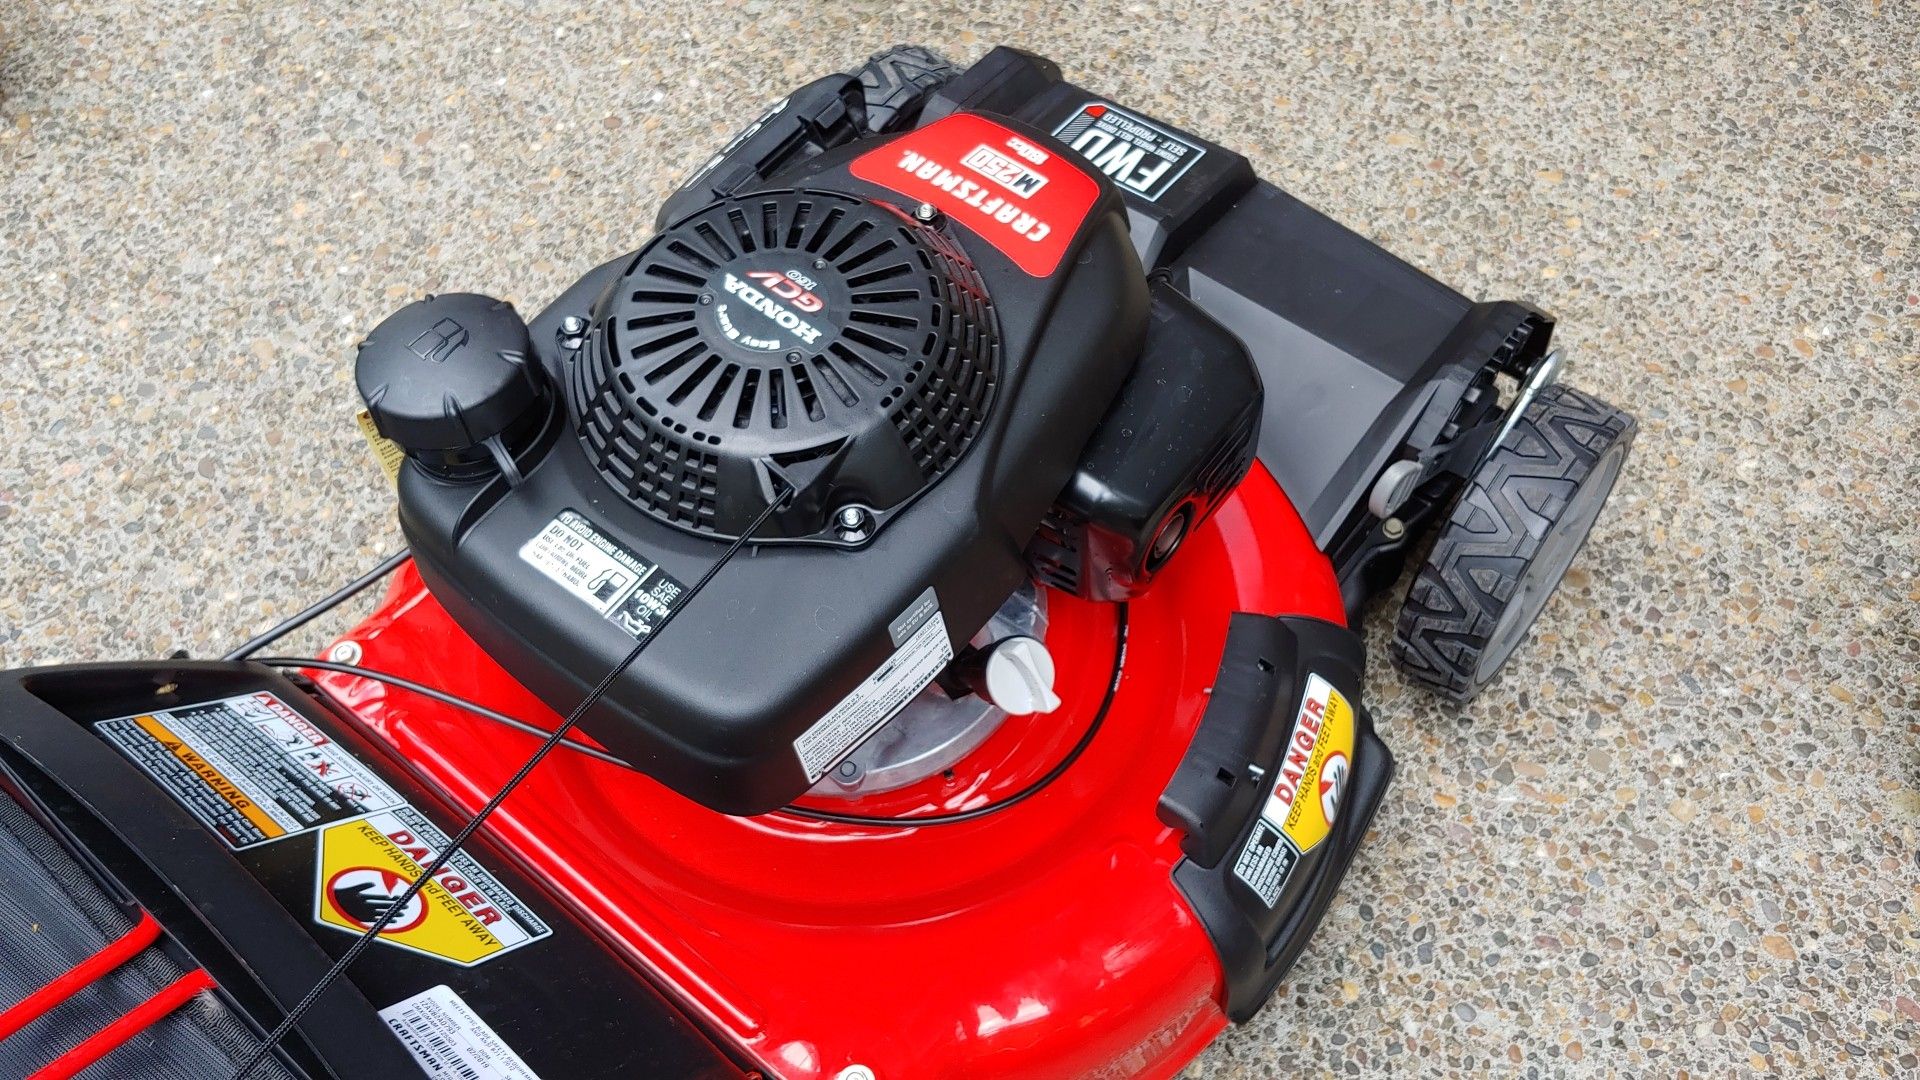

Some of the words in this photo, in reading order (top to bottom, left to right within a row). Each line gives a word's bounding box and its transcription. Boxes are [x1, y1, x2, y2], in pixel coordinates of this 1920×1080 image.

[1100, 111, 1159, 142] PROPELLED
[1113, 129, 1135, 142] BELT
[1130, 137, 1158, 153] WHEEL
[1152, 147, 1180, 163] FRONT
[1159, 139, 1189, 156] SELF
[966, 148, 1041, 193] M250
[897, 152, 1051, 242] CRAFTSMAN
[724, 272, 823, 344] HONDA
[745, 270, 825, 313] GCV
[548, 524, 566, 538] DO
[562, 534, 585, 551] NOT
[559, 512, 574, 524] TO
[568, 518, 594, 538] AVOID
[588, 532, 619, 555] ENGINE
[612, 549, 648, 575] DAMAGE
[648, 586, 675, 605] SAE
[655, 577, 683, 598] USE
[634, 603, 657, 621] OIL
[268, 704, 326, 743] DANGER
[1322, 693, 1341, 725] AWAY
[1273, 696, 1326, 807] DANGER
[1316, 722, 1332, 749] FEET
[1310, 747, 1324, 768] and
[178, 751, 253, 809] WARNING
[1296, 763, 1318, 803] HANDS
[1285, 798, 1303, 831] KEEP
[355, 824, 390, 847] KEEP
[380, 846, 424, 878] HANDS
[433, 894, 468, 917] FEET
[458, 918, 499, 947] AWAY
[386, 829, 503, 927] DANGER
[474, 872, 516, 904] UNDAMAGED
[509, 904, 547, 933] DISCHARGE
[388, 1018, 442, 1072] CRAFTSMAN
